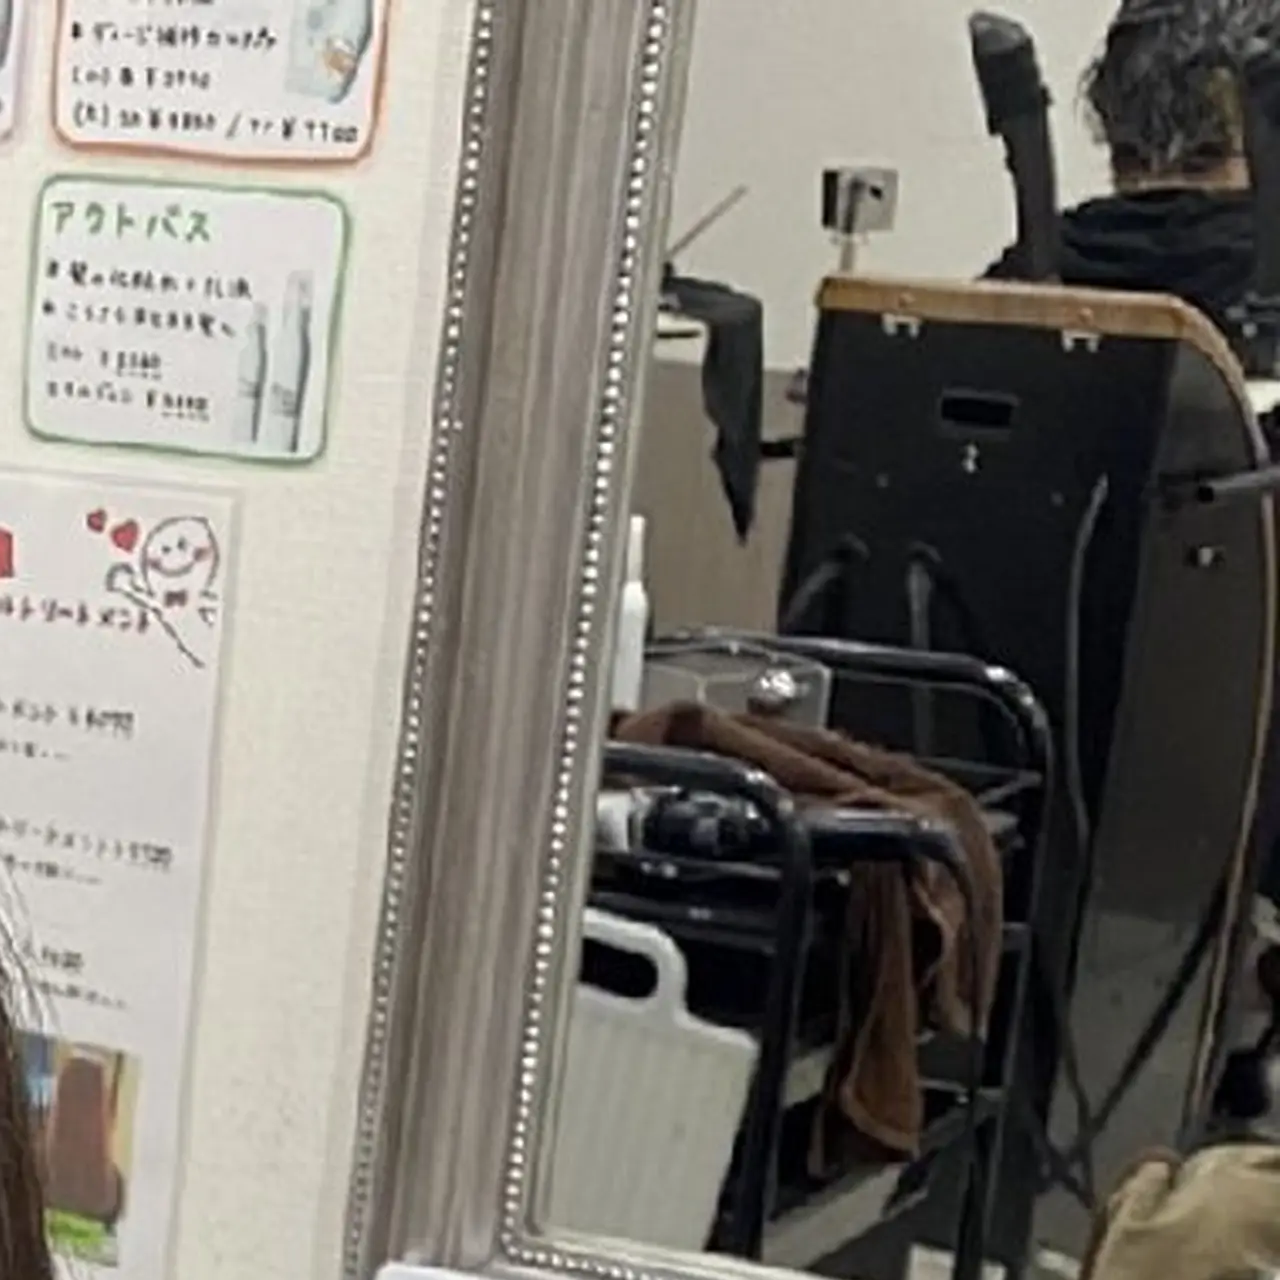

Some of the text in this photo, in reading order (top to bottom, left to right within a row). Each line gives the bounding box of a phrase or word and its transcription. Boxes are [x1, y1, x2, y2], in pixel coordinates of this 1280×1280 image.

[51, 201, 210, 242] アクトバス
